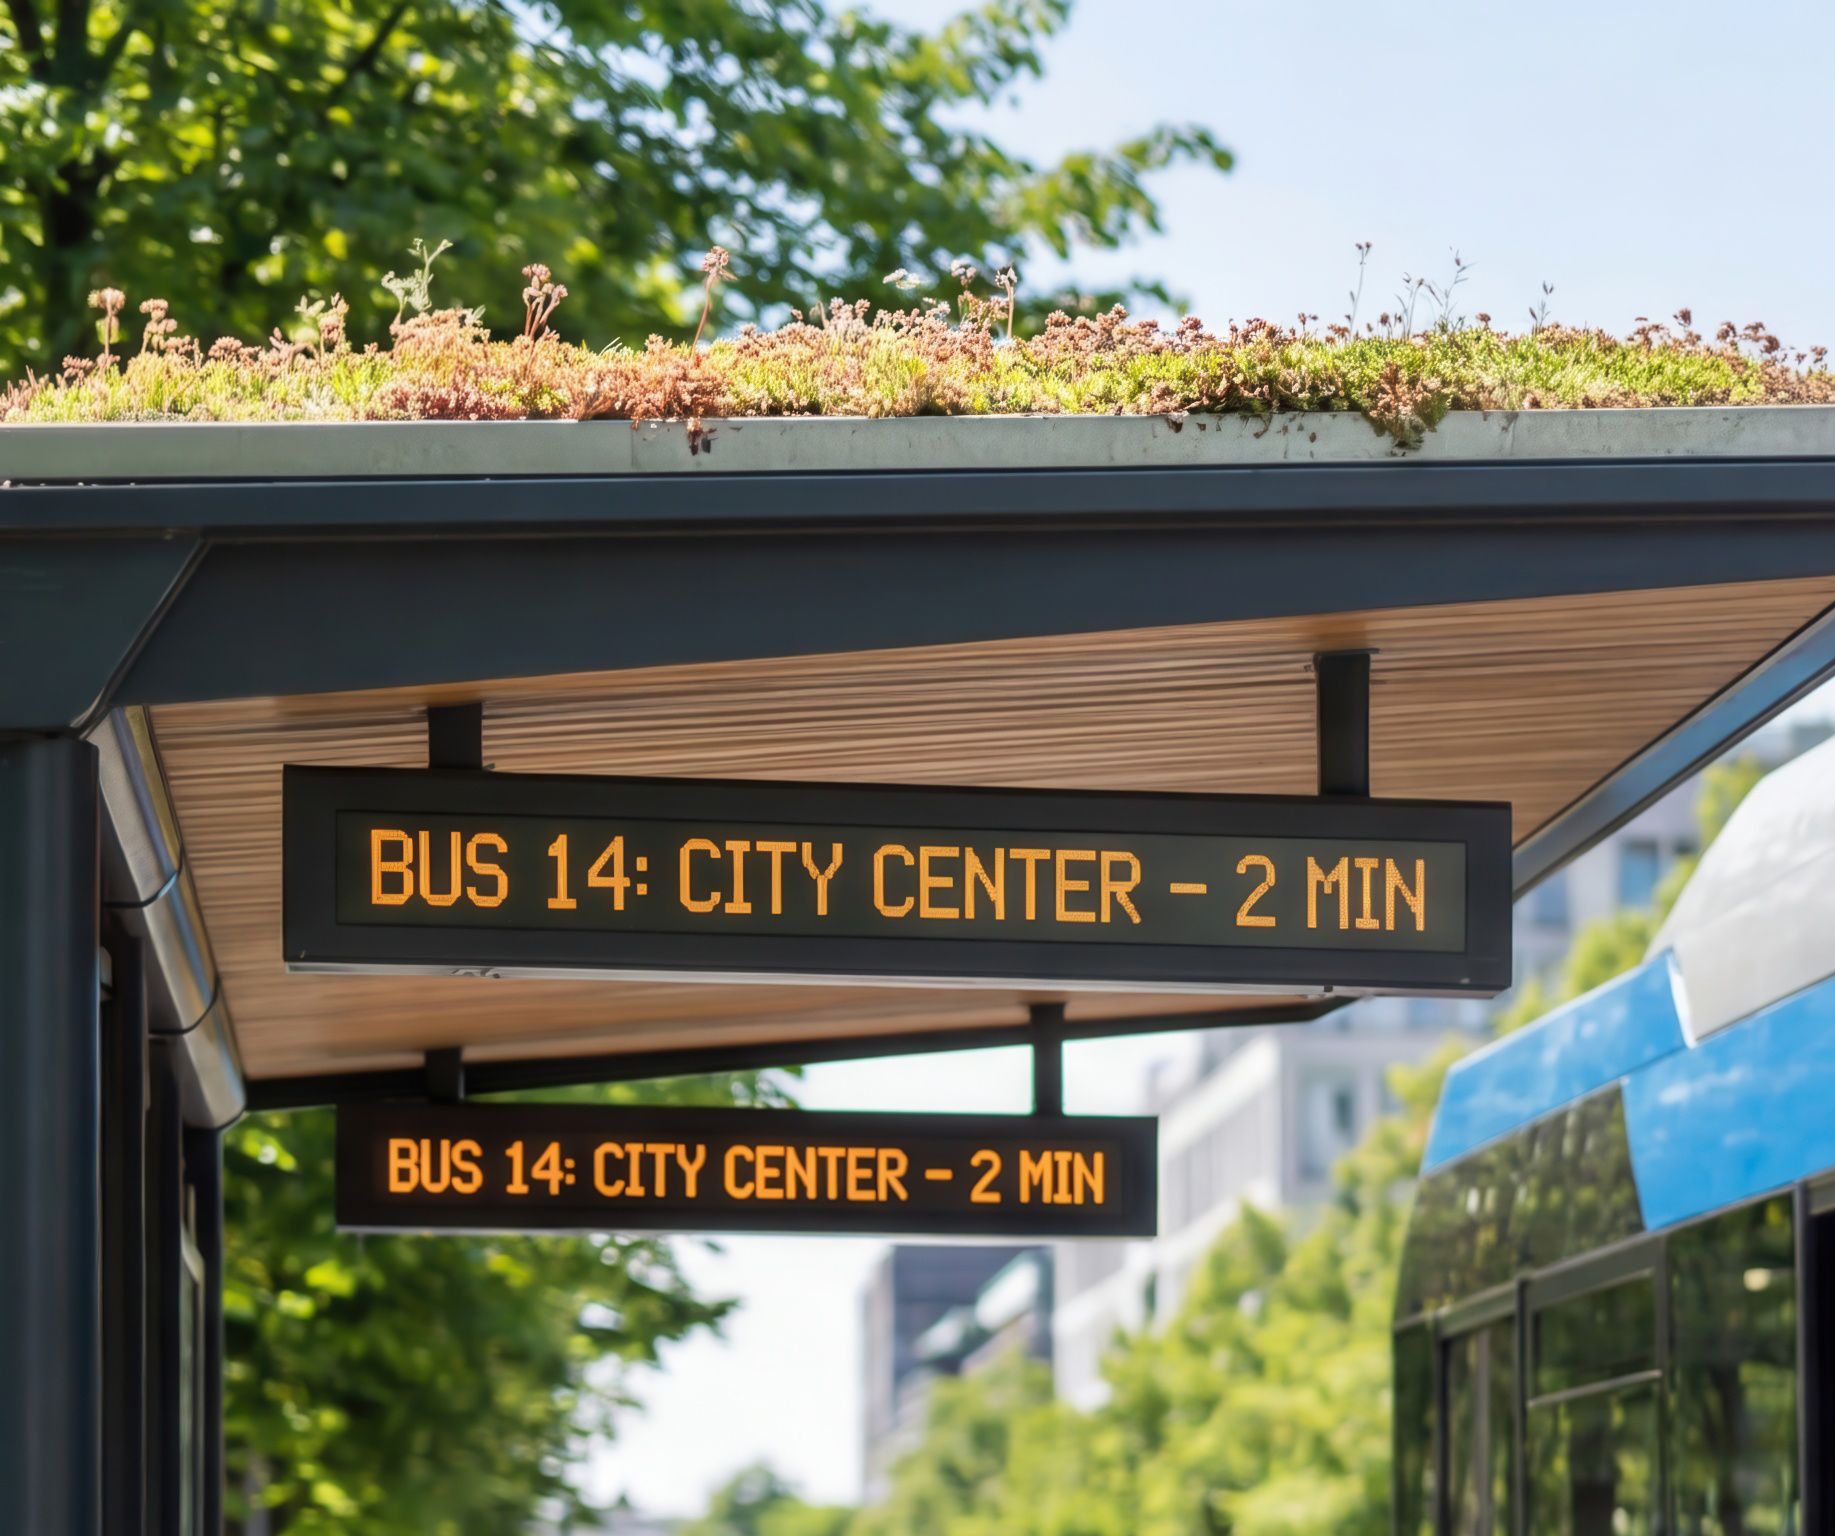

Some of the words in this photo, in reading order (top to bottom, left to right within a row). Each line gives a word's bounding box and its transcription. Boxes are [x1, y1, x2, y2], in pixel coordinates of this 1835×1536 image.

[369, 828, 510, 908] BUS
[546, 832, 649, 912] 14:
[678, 837, 844, 917] CITY
[872, 843, 1142, 925] CENTER
[1235, 853, 1277, 928] 2
[1306, 855, 1426, 932] MIN
[387, 1137, 484, 1195] BUS
[504, 1140, 576, 1196] 14:
[593, 1141, 707, 1199] CITY
[723, 1144, 909, 1202] CENTER
[969, 1148, 1003, 1204] 2
[1018, 1148, 1105, 1206] MIN
